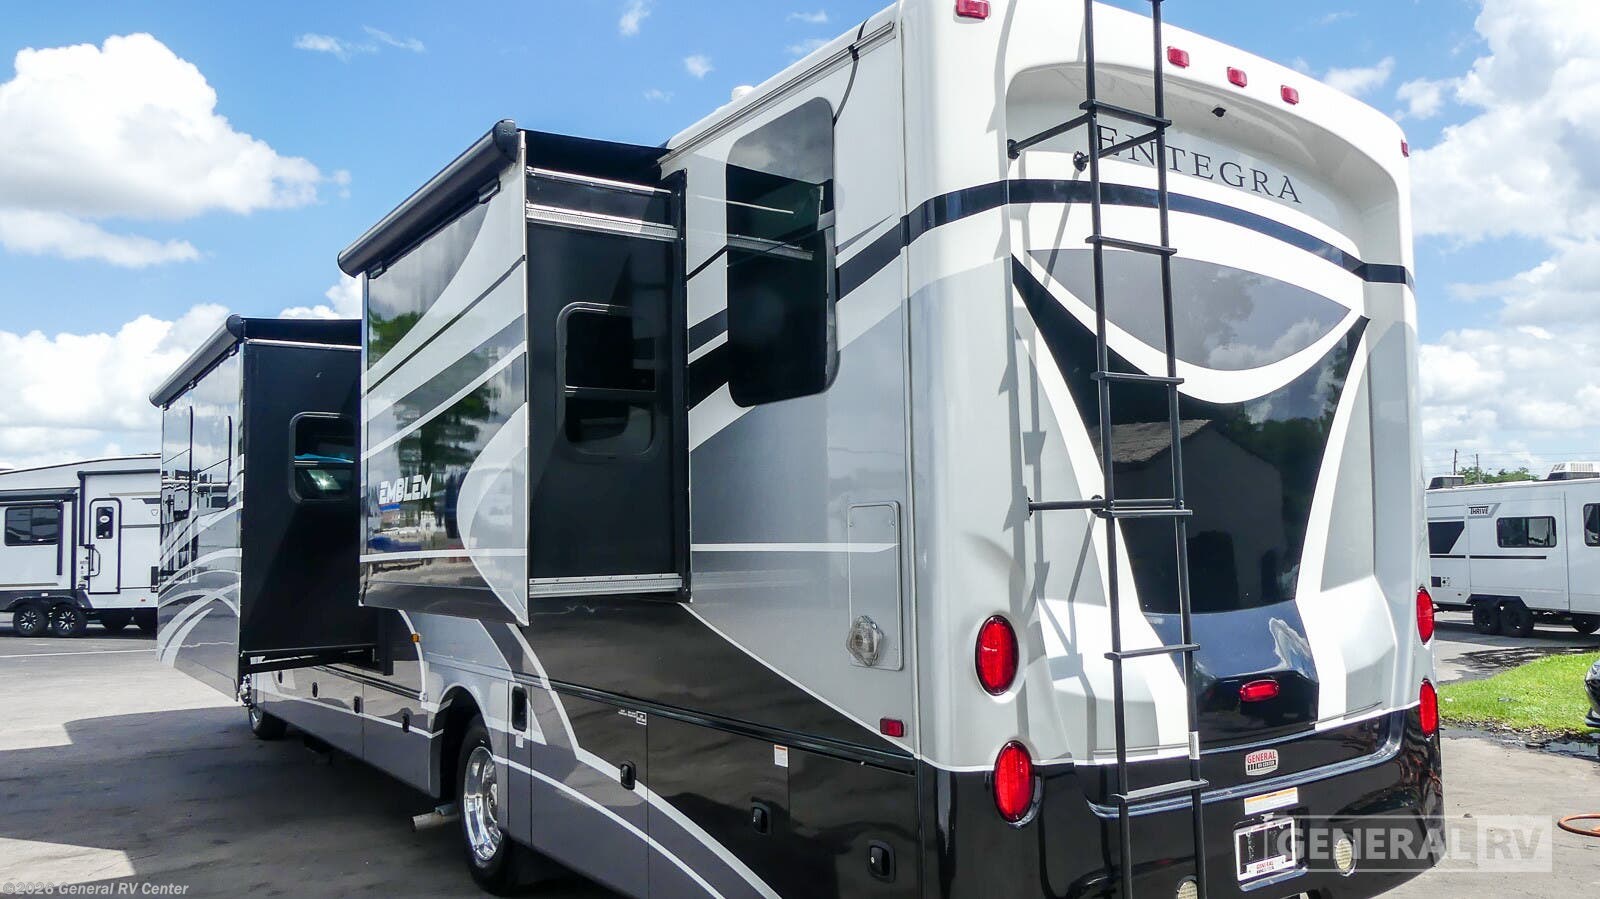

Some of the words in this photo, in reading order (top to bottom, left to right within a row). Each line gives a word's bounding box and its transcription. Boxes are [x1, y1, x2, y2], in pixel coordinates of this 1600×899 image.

[1097, 125, 1302, 203] ENTEGRA
[379, 473, 433, 504] EMBLEM
[1468, 506, 1489, 515] THRIVE
[1247, 751, 1276, 764] GENERAL
